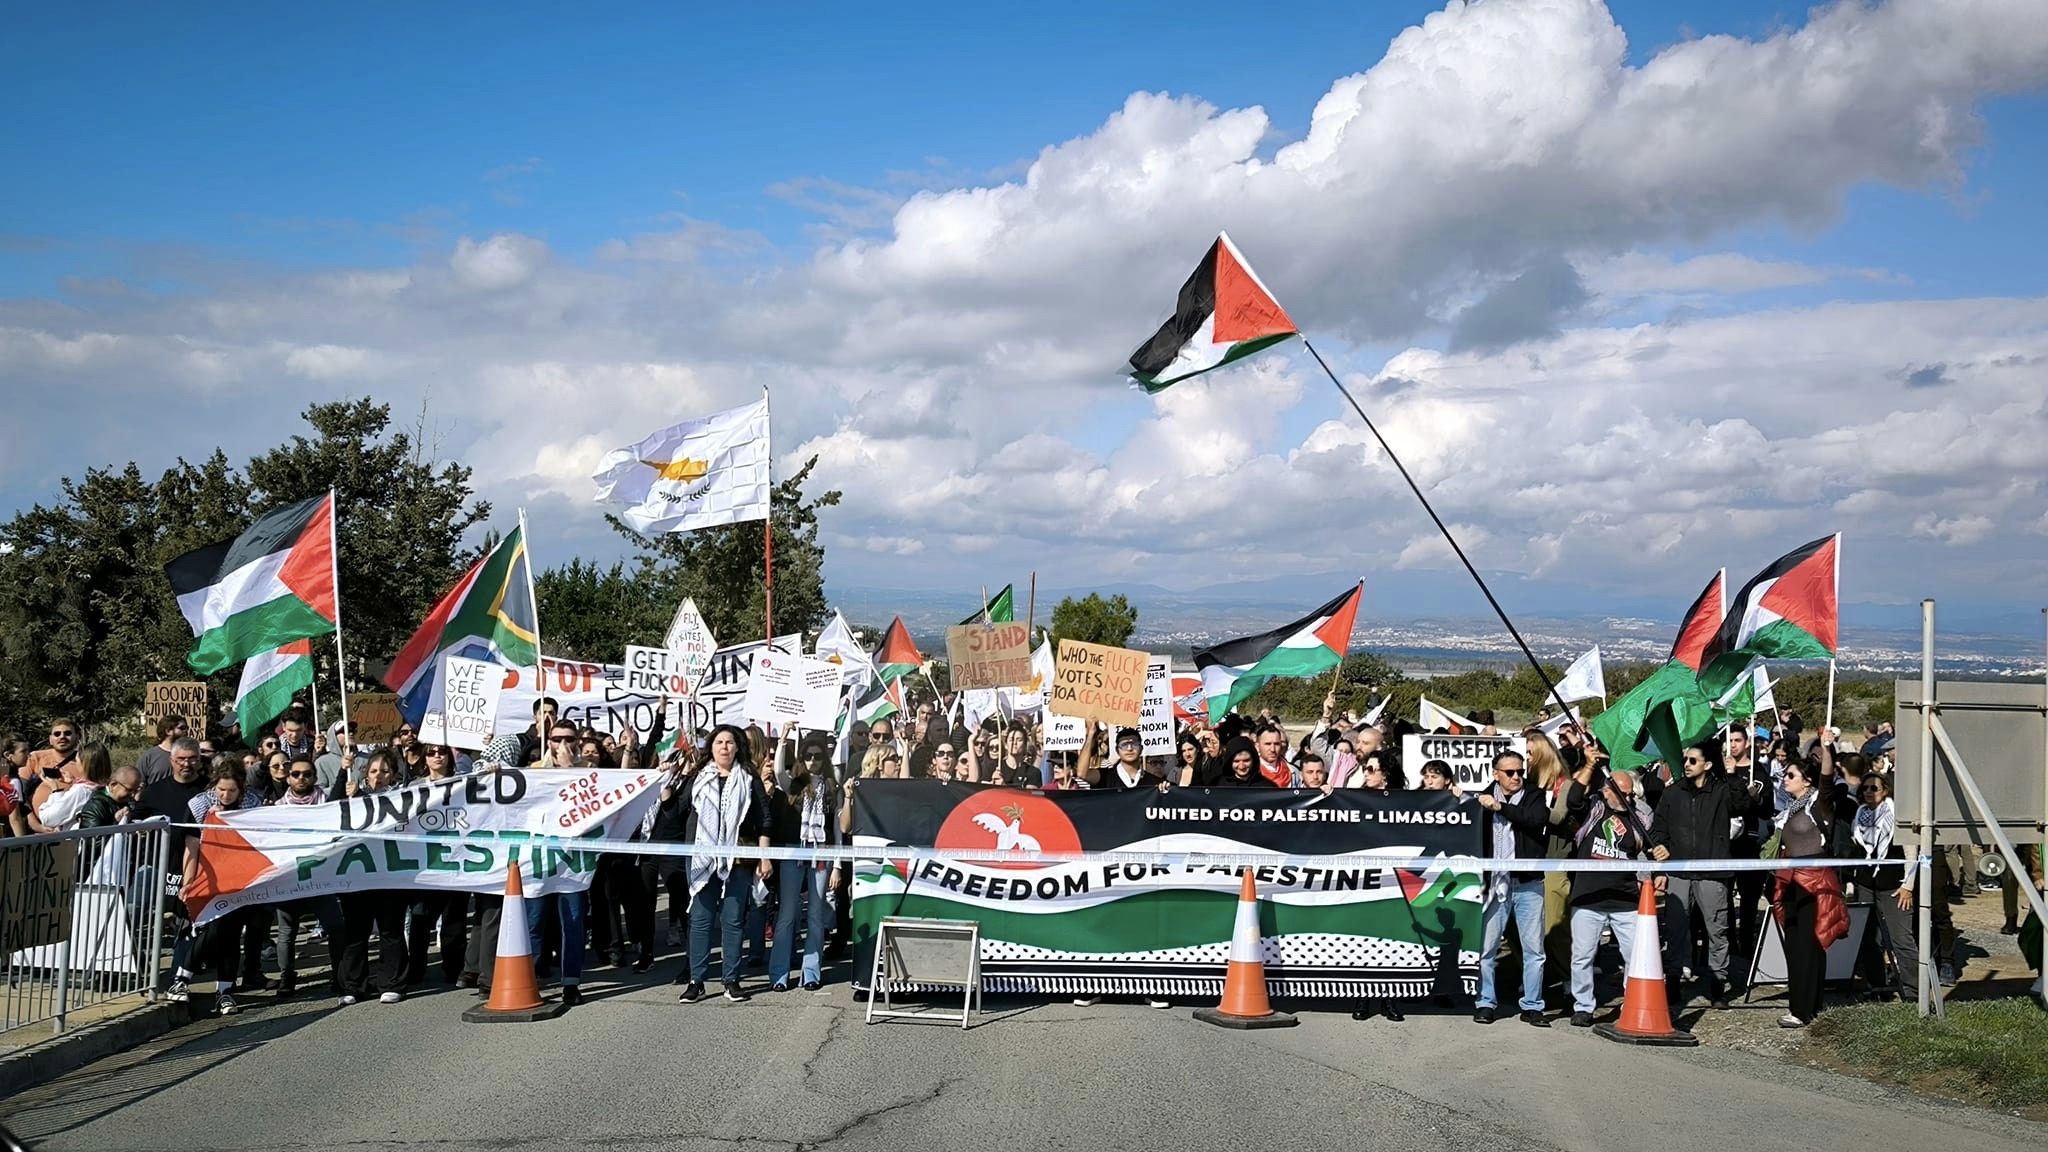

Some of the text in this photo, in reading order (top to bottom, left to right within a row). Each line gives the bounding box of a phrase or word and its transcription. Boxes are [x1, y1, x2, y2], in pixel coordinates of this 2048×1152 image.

[969, 625, 1026, 651] STAND
[451, 661, 486, 681] WE
[634, 650, 668, 671] GET
[1060, 646, 1143, 676] WHO THE FUCK
[629, 671, 669, 692] FUCK
[670, 674, 689, 695] OU
[953, 656, 1031, 688] PALESTINE
[1058, 667, 1132, 693] VOTES NO
[152, 685, 205, 702] 100 DEAD
[447, 679, 480, 696] SEE
[446, 694, 487, 715] YOUR
[1079, 688, 1140, 715] CEASEFIRE
[425, 714, 492, 735] GENOCIDE
[561, 696, 728, 734] GENOCIDE
[188, 727, 204, 740] AYS
[1055, 722, 1074, 732] Free
[1045, 736, 1085, 746] Palestine
[558, 771, 599, 802] STOP
[570, 785, 600, 806] THE
[340, 768, 527, 832] UNITED
[559, 774, 648, 828] GENOCIDE
[1146, 807, 1213, 821] UNITED
[1219, 808, 1256, 822] FOR
[1261, 810, 1360, 823] PALESTINE
[1378, 809, 1472, 826] LIMASSOL
[919, 858, 1090, 901] FREEDOM
[1103, 861, 1171, 888] FOR
